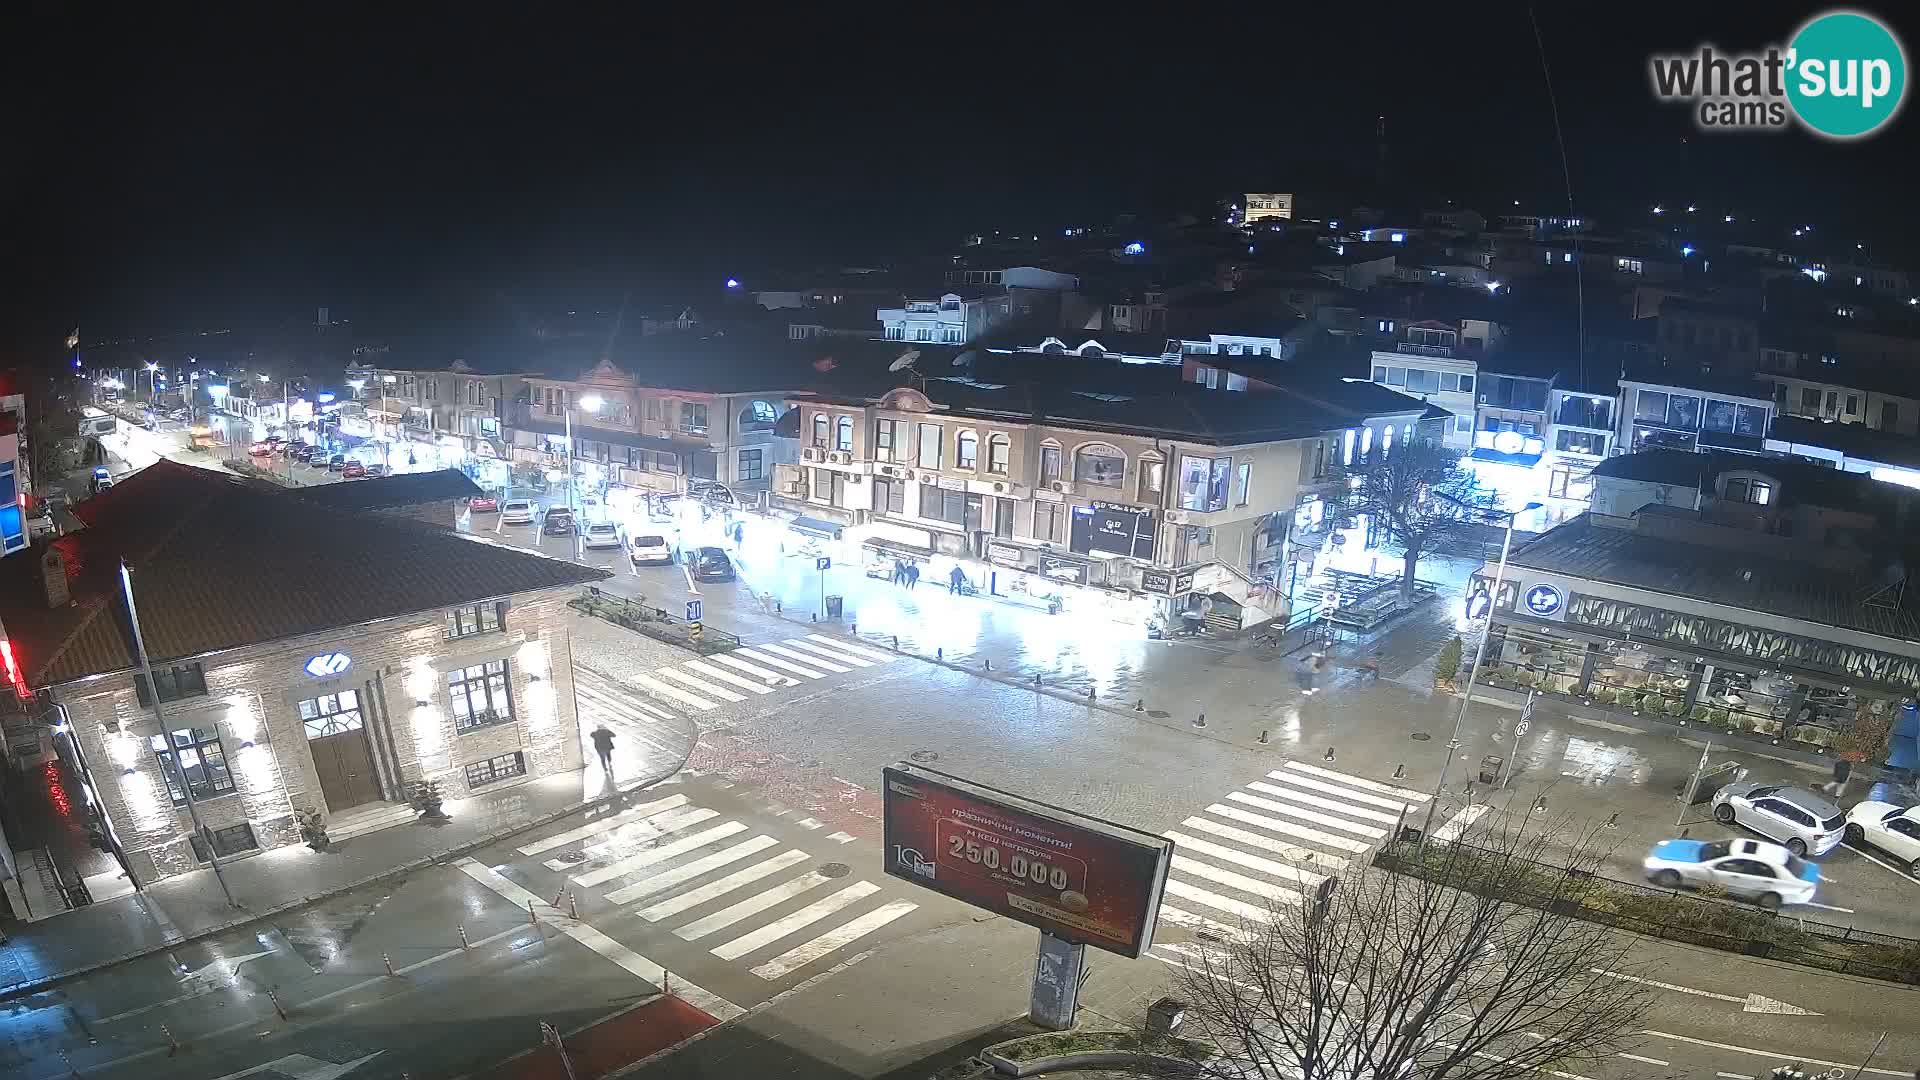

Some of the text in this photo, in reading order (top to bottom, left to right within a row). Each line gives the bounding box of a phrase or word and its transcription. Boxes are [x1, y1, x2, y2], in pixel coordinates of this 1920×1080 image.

[819, 558, 828, 569] P
[951, 808, 1073, 850] празнични моменти!
[948, 835, 1068, 890] 250.000
